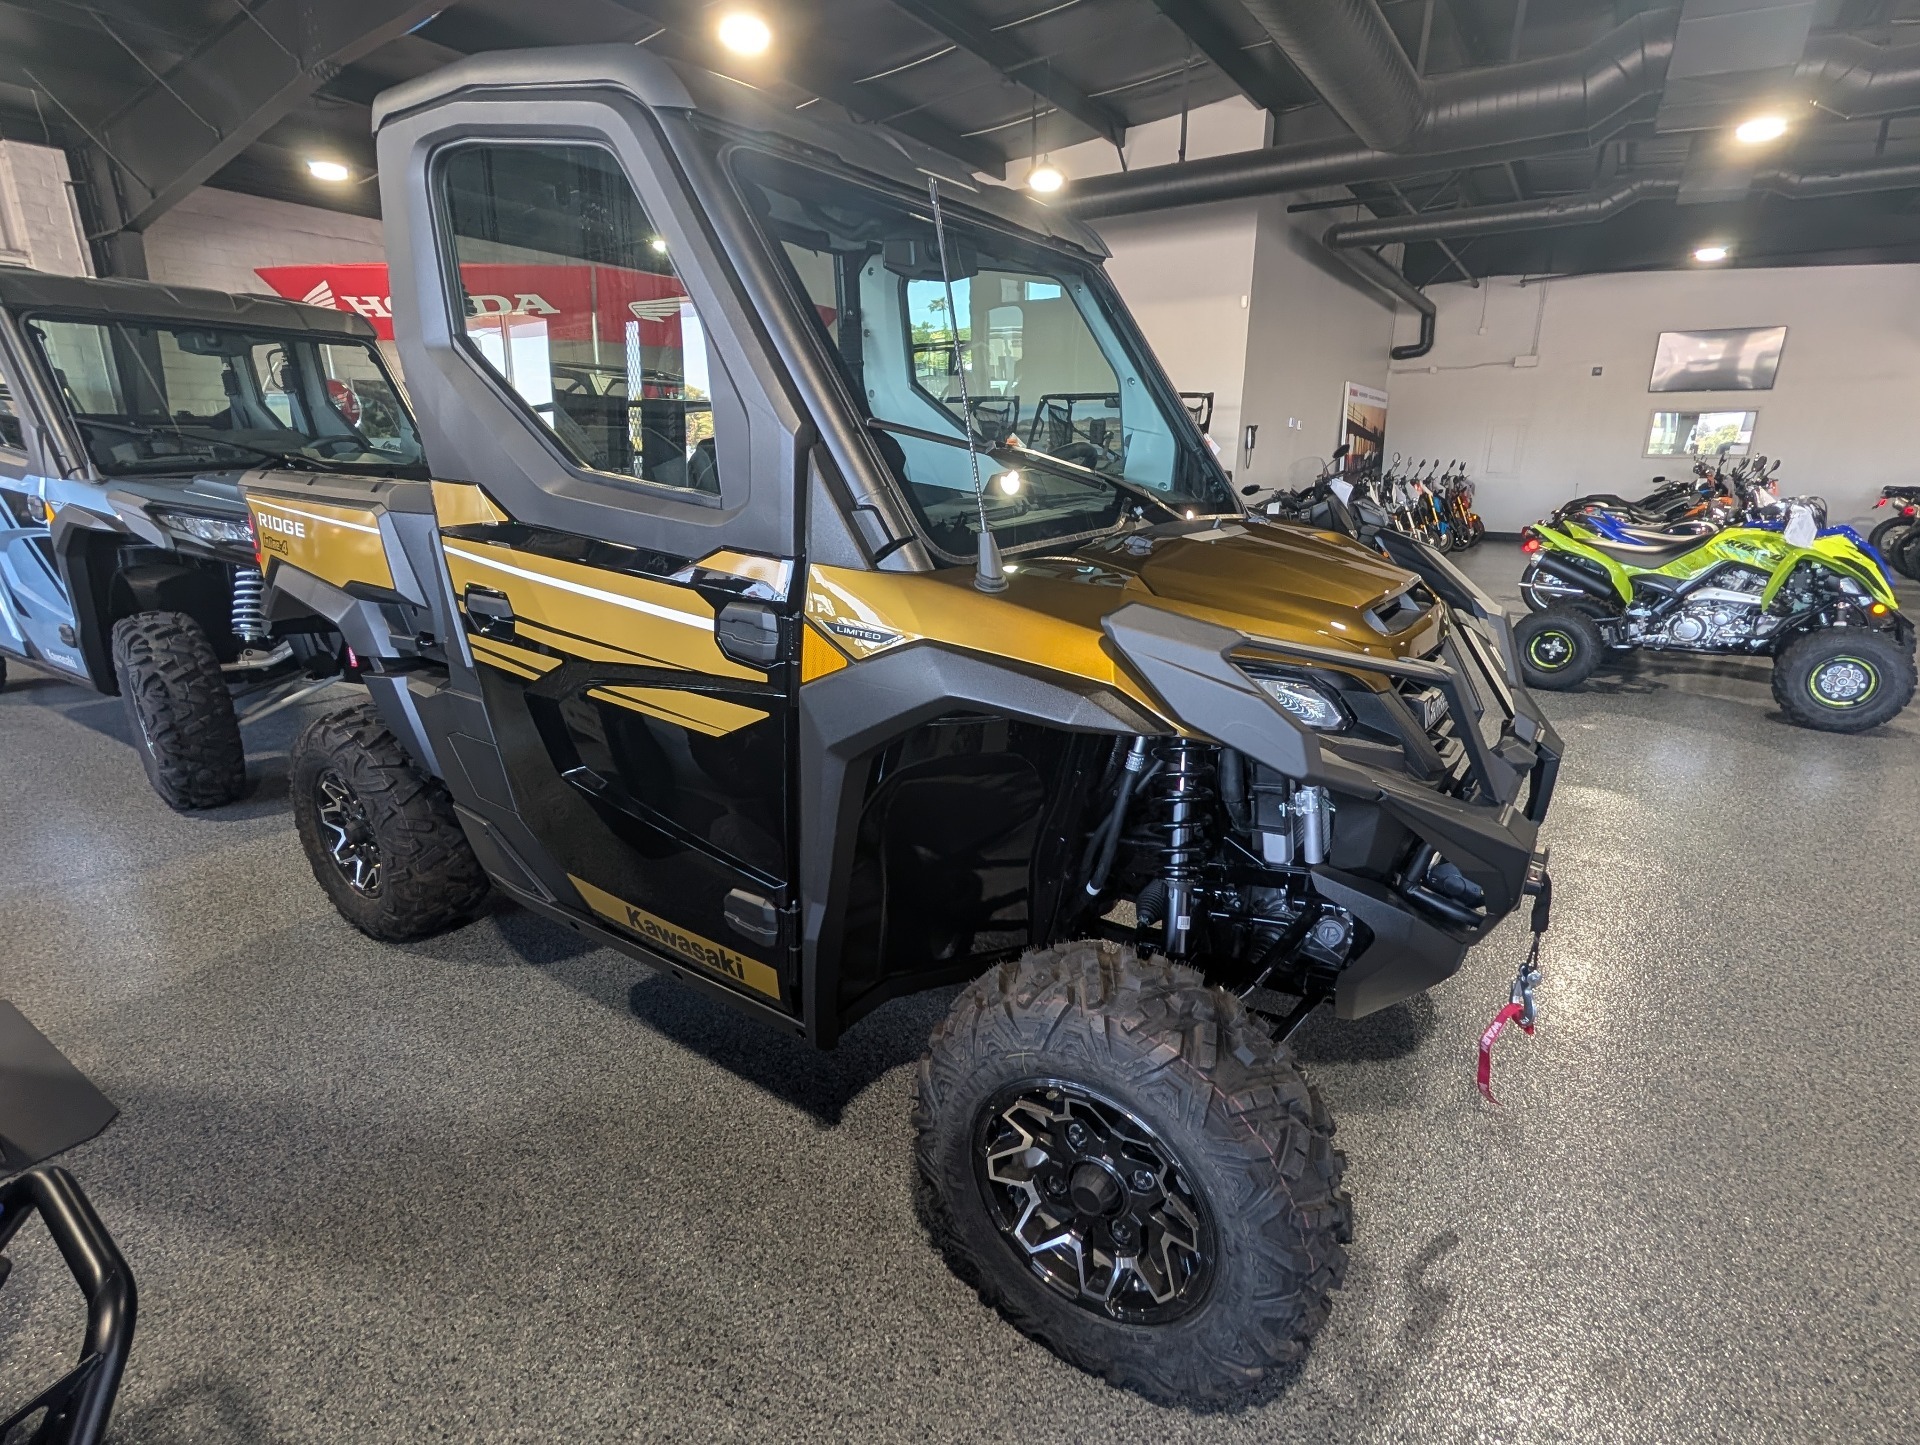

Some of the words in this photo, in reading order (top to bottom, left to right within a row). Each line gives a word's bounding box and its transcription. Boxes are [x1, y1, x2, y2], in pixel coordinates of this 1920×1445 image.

[257, 511, 306, 538] RIDGE
[836, 625, 881, 640] LIMITED
[625, 905, 745, 980] Kawasaki
